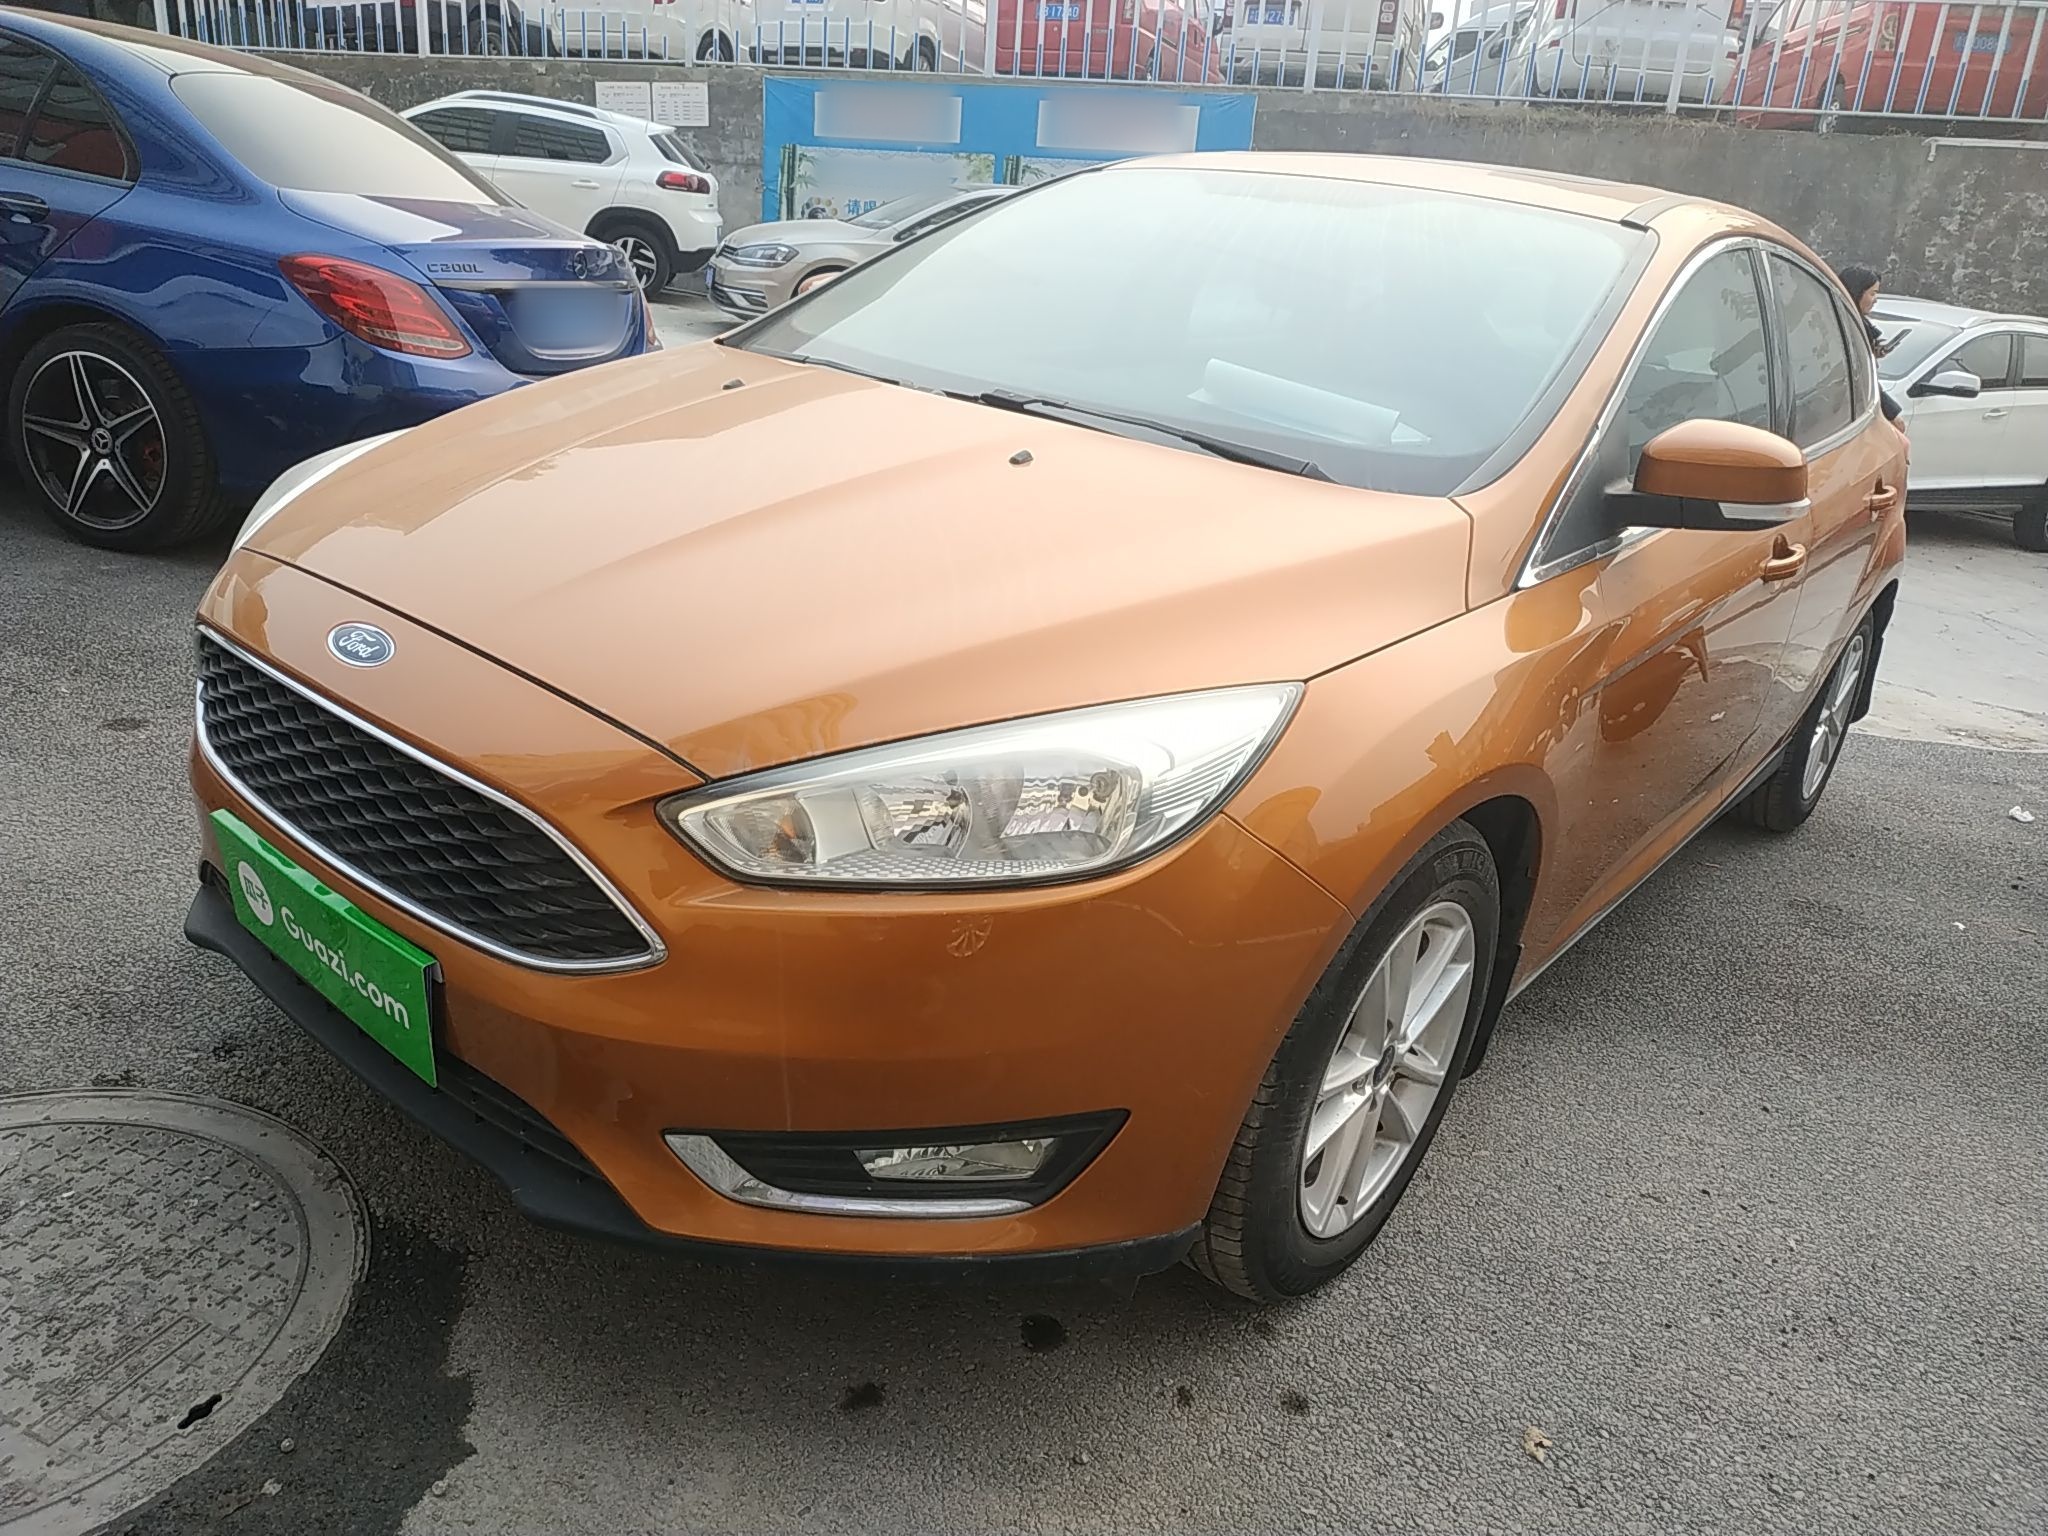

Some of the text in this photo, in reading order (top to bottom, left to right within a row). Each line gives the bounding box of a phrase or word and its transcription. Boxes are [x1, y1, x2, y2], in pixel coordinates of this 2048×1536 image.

[426, 263, 484, 273] C200L
[338, 630, 381, 658] Ford
[243, 874, 269, 910] 瓜子
[281, 906, 410, 1030] Guazi.com
